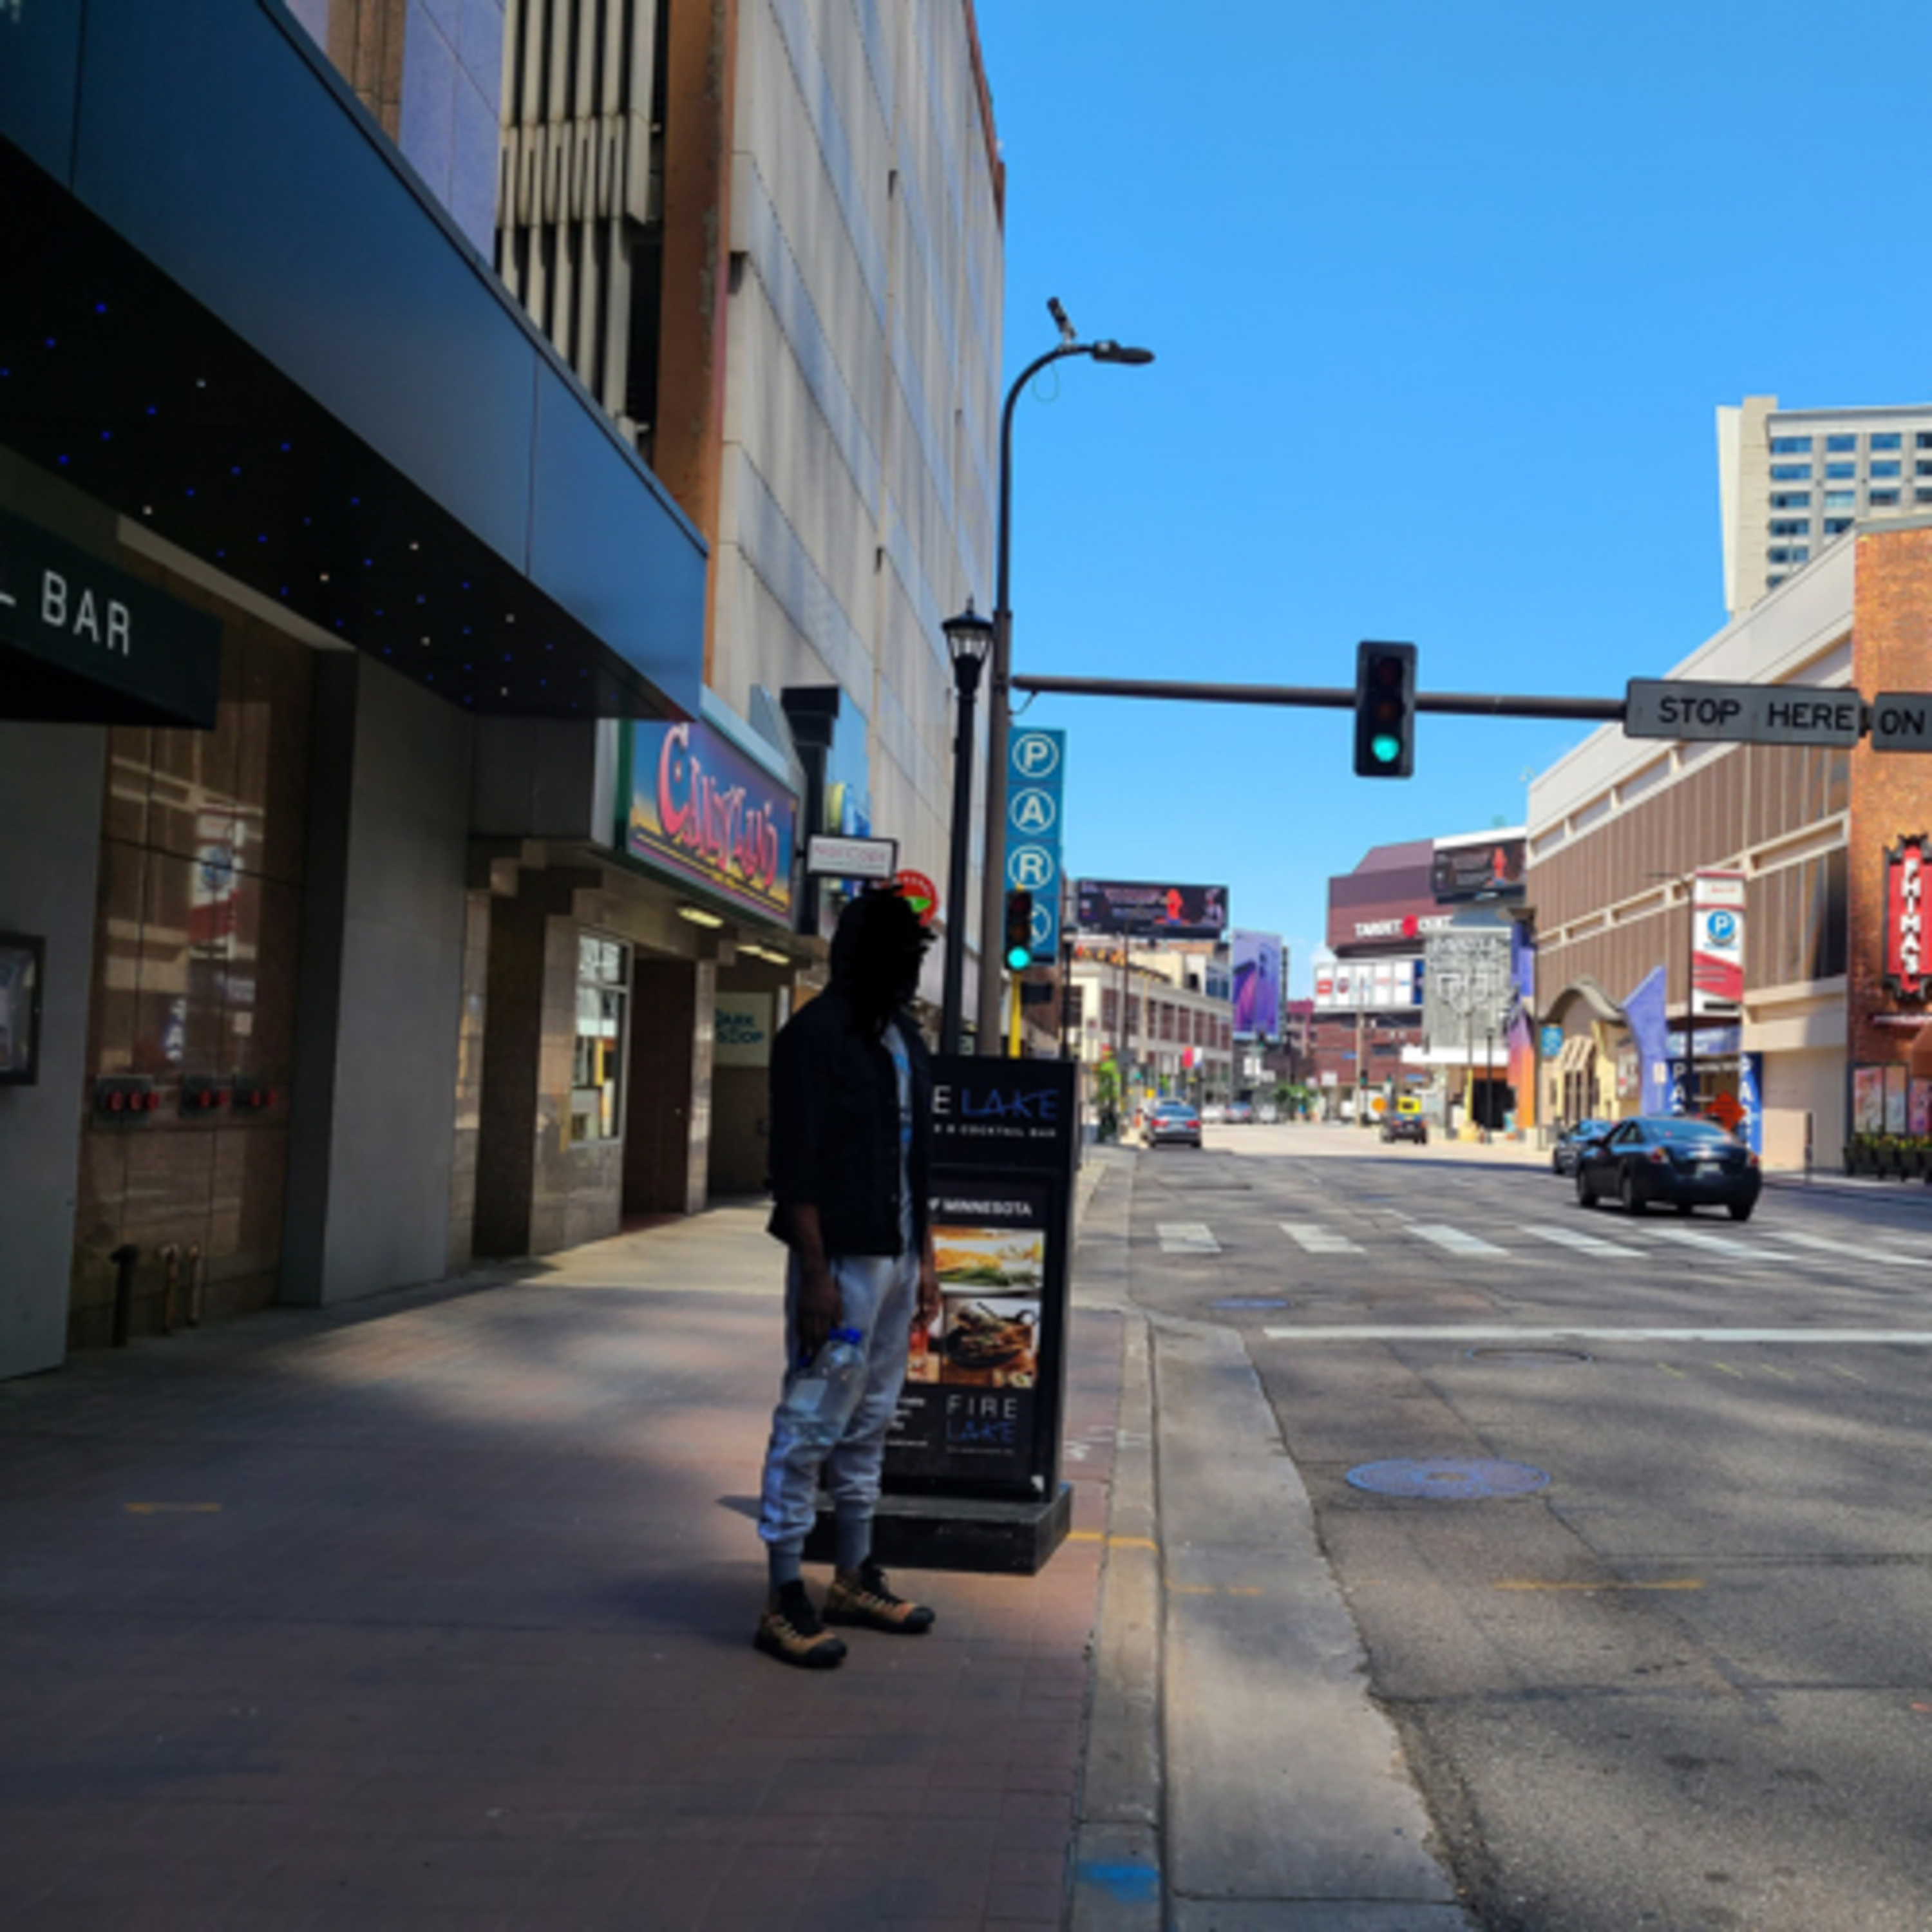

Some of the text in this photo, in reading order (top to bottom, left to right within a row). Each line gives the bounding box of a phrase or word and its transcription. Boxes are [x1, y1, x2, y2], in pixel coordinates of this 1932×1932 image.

[42, 569, 130, 656] BAR
[1658, 696, 1924, 735] STOP HERE ON
[961, 1088, 1059, 1120] LAKE
[942, 1198, 1033, 1217] MINNESOTA
[947, 1394, 1017, 1419] FIRE
[946, 1419, 1014, 1443] LAKE
